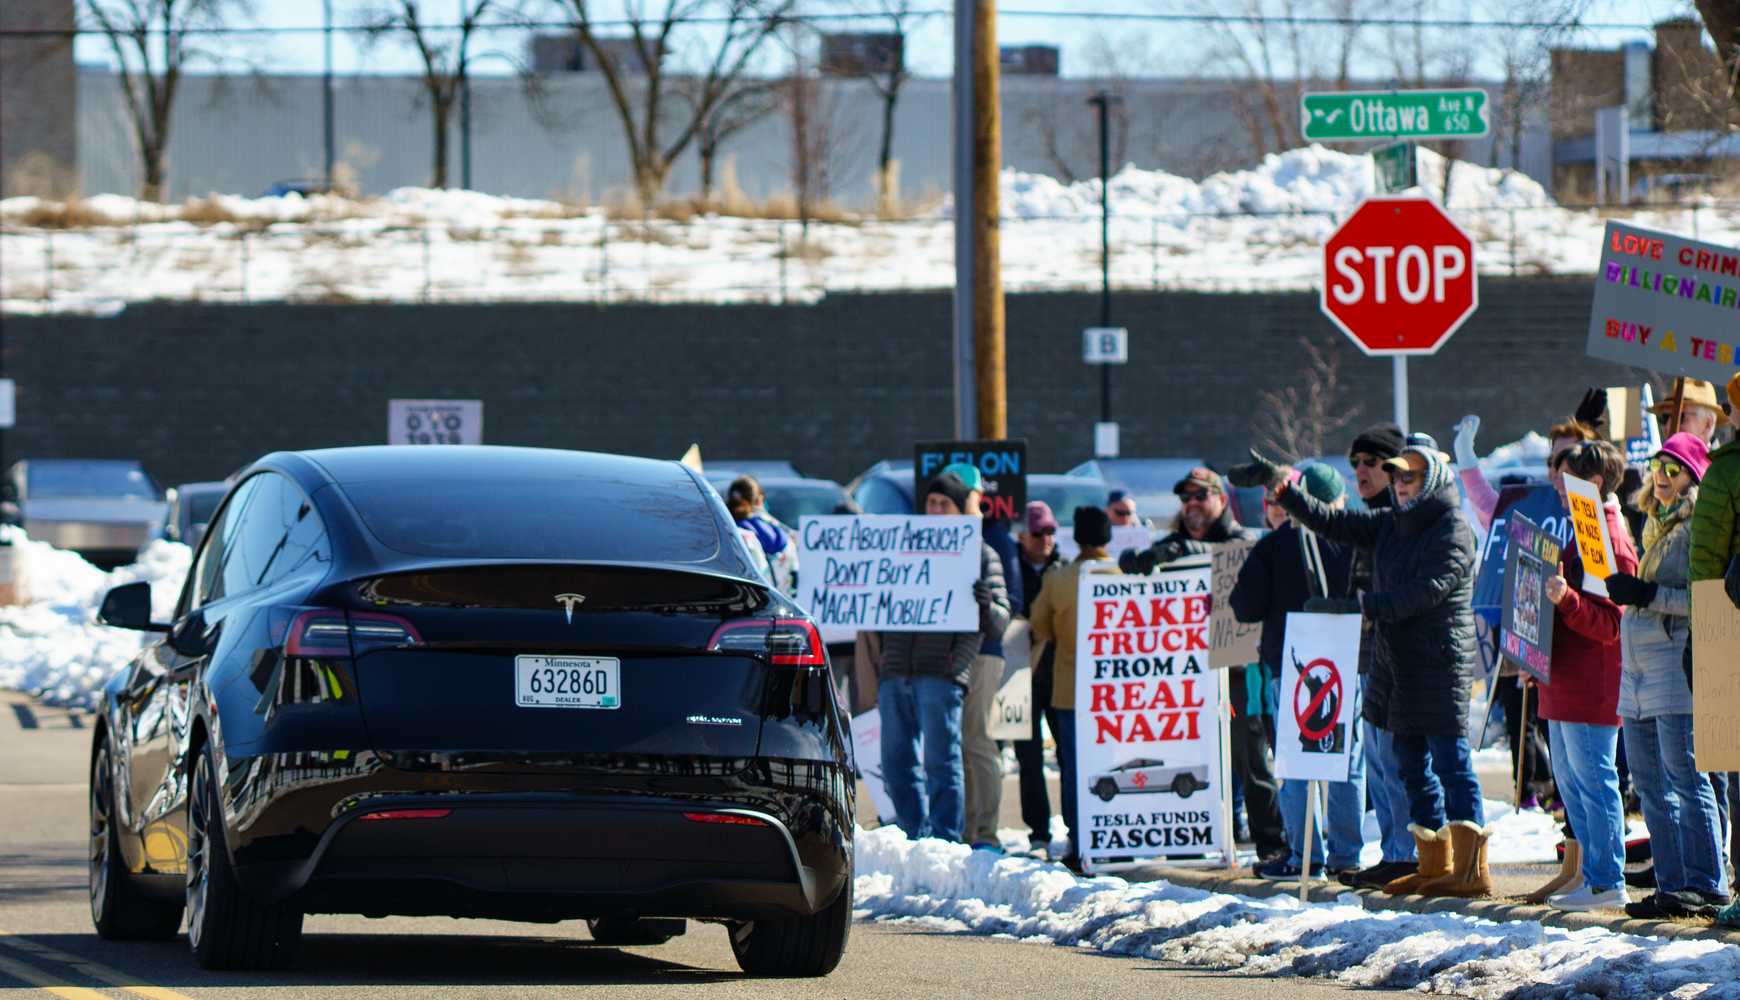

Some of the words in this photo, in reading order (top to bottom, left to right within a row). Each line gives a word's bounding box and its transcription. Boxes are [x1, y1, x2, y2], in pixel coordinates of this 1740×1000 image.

[1351, 99, 1430, 132] Ottawa
[1438, 96, 1460, 113] Ave
[1465, 96, 1474, 111] N
[1444, 115, 1470, 131] 650
[1611, 230, 1665, 261] LOVE
[1678, 246, 1740, 278] CRIM
[1332, 244, 1466, 305] STOP
[1606, 260, 1740, 310] BILLIONAIR
[1605, 318, 1652, 346] BUY
[1659, 329, 1678, 353] A
[1691, 335, 1740, 366] TESL
[804, 520, 847, 550] CARE
[851, 518, 900, 551] ABOUT
[901, 520, 974, 553] AMERICA?
[876, 557, 914, 585] BUY
[915, 558, 930, 584] A
[1093, 582, 1147, 597] DON'T
[1152, 580, 1189, 594] BUY
[1195, 580, 1208, 591] A
[811, 588, 952, 624] MAGAT-MOBILE!
[1093, 594, 1211, 630] FAKE
[1087, 626, 1209, 656] TRUCK
[544, 658, 591, 668] Minnesota
[1094, 656, 1175, 679] FROM
[1182, 654, 1202, 675] A
[530, 668, 607, 695] 63286D
[1089, 679, 1205, 712] REAL
[1094, 711, 1201, 744] NAZI
[1091, 813, 1146, 827] TESLA
[1151, 811, 1210, 825] FUNDS
[1090, 826, 1213, 850] FASCISM
